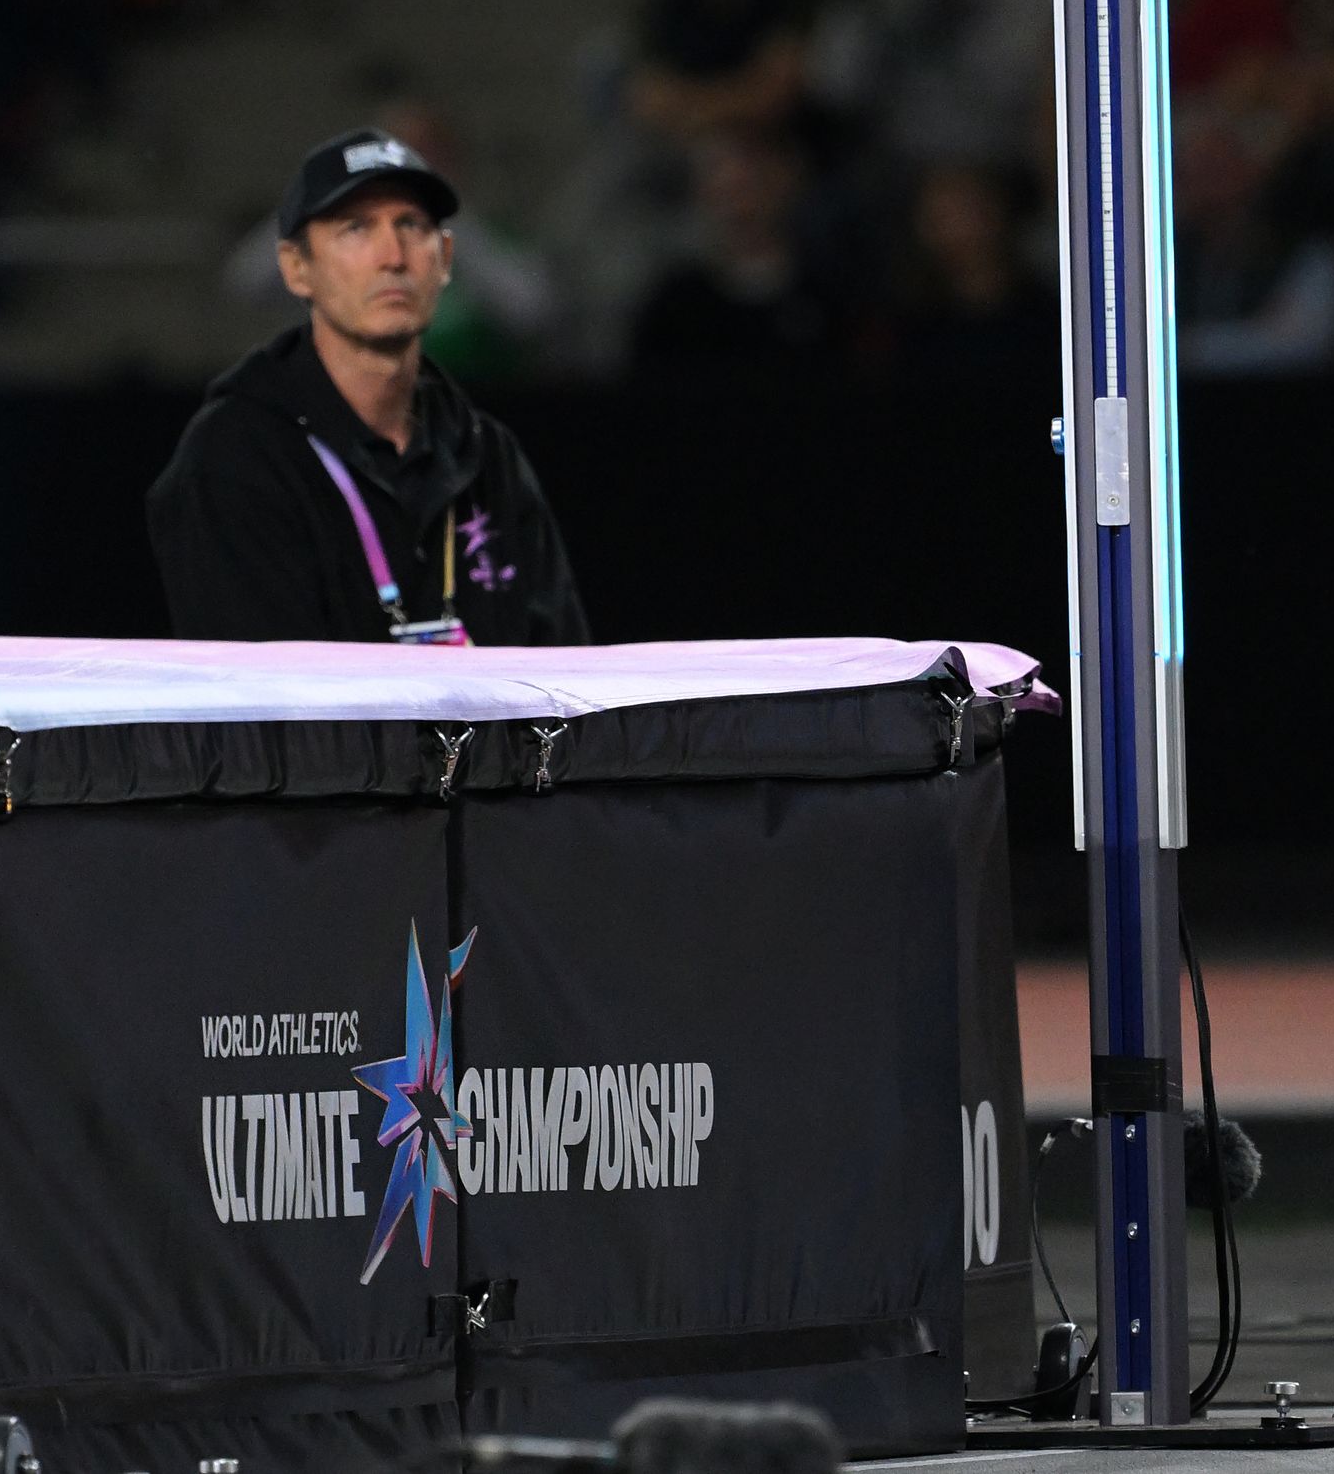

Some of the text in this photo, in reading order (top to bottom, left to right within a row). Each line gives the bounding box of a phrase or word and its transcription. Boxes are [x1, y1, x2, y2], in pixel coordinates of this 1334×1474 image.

[201, 1010, 360, 1059] WORLD ATHLETICS
[201, 1062, 714, 1224] ULTIMATE CHAMPIONSHIP
